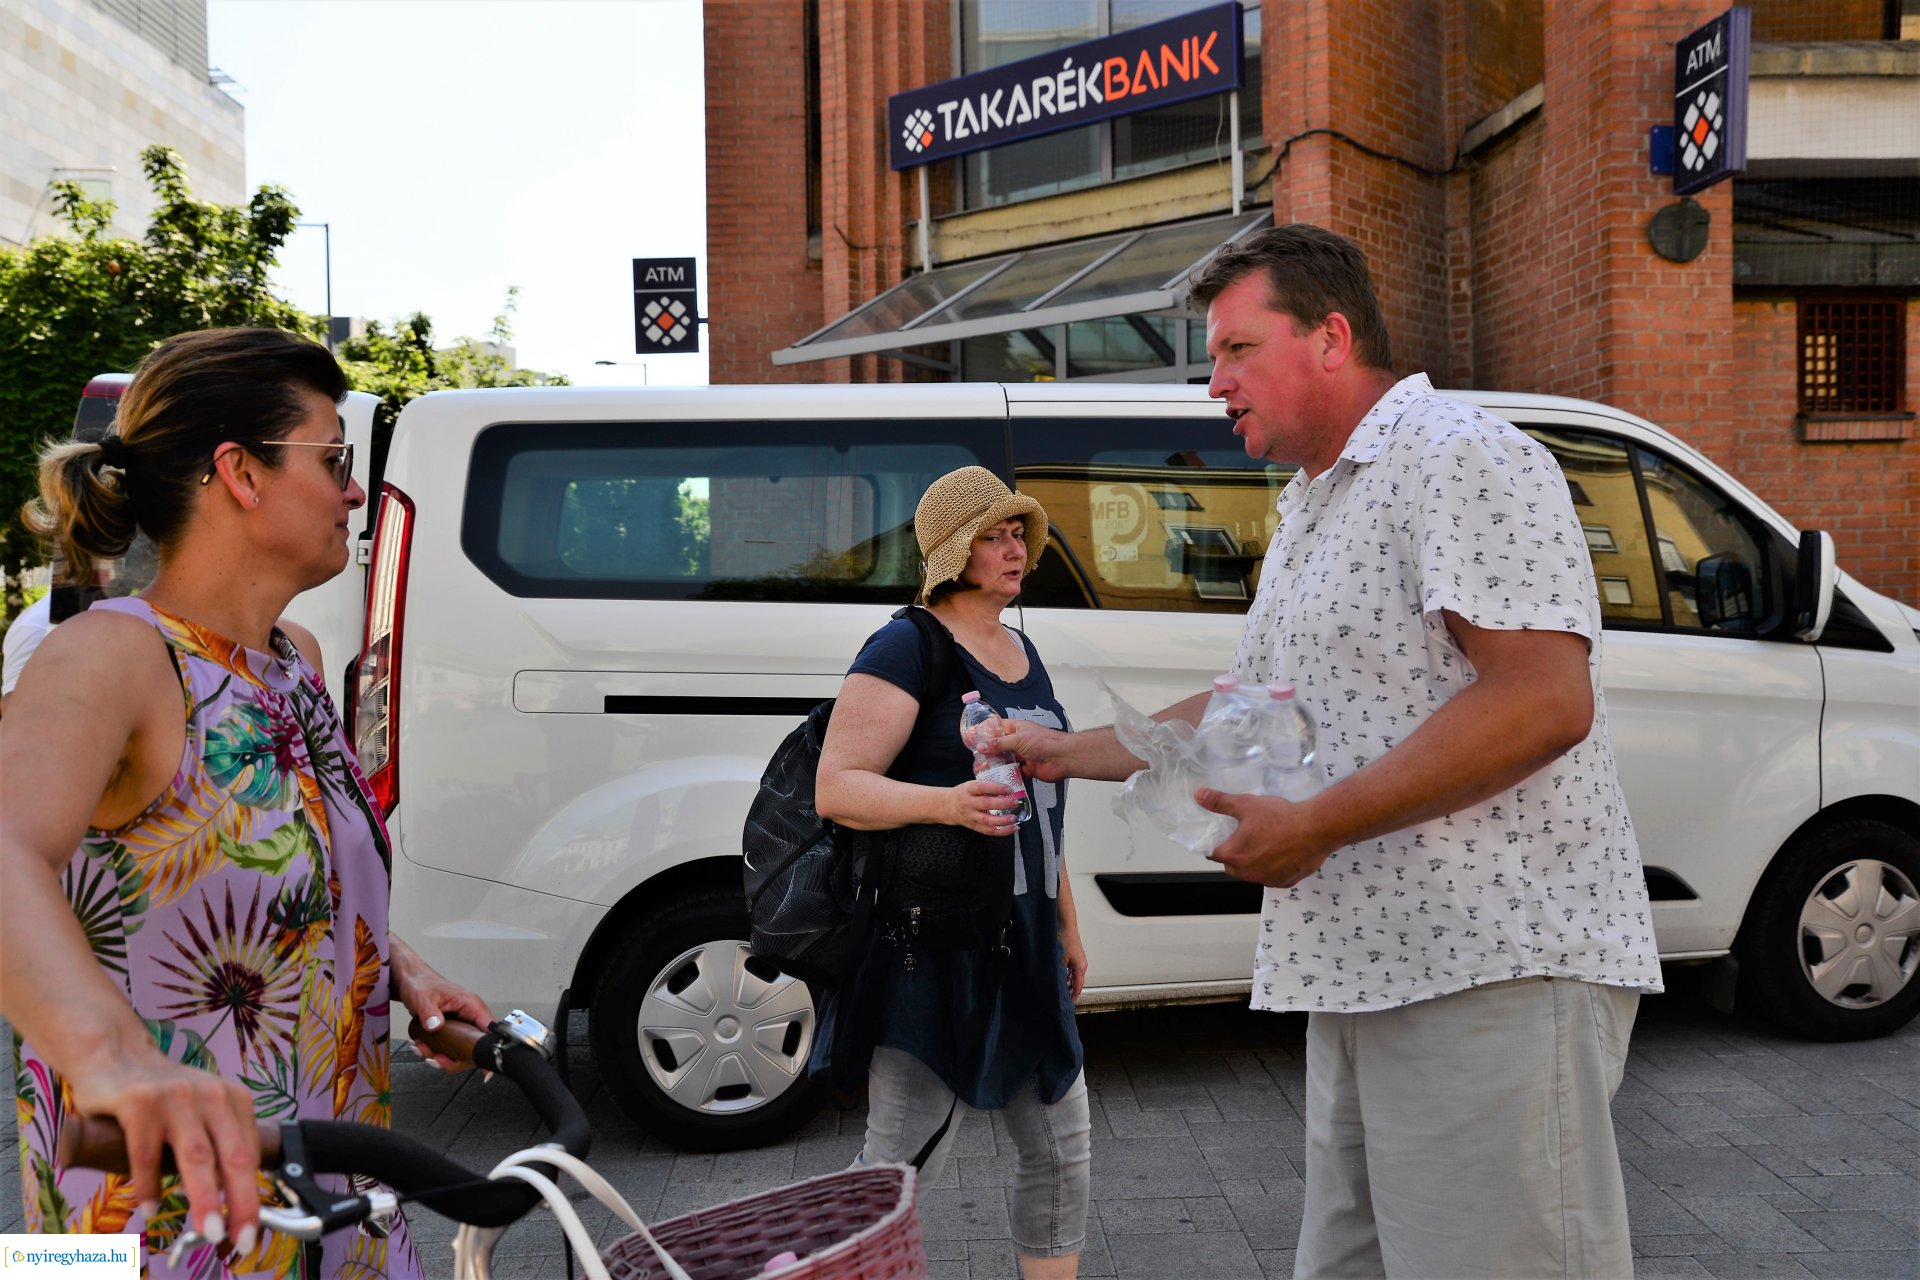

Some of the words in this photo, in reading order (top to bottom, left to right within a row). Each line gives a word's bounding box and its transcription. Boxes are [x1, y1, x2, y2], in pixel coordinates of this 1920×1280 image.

[1685, 32, 1721, 76] ATM
[937, 31, 1219, 142] TAKARÉKBANK
[645, 266, 685, 282] ATM
[1091, 501, 1130, 520] MFB
